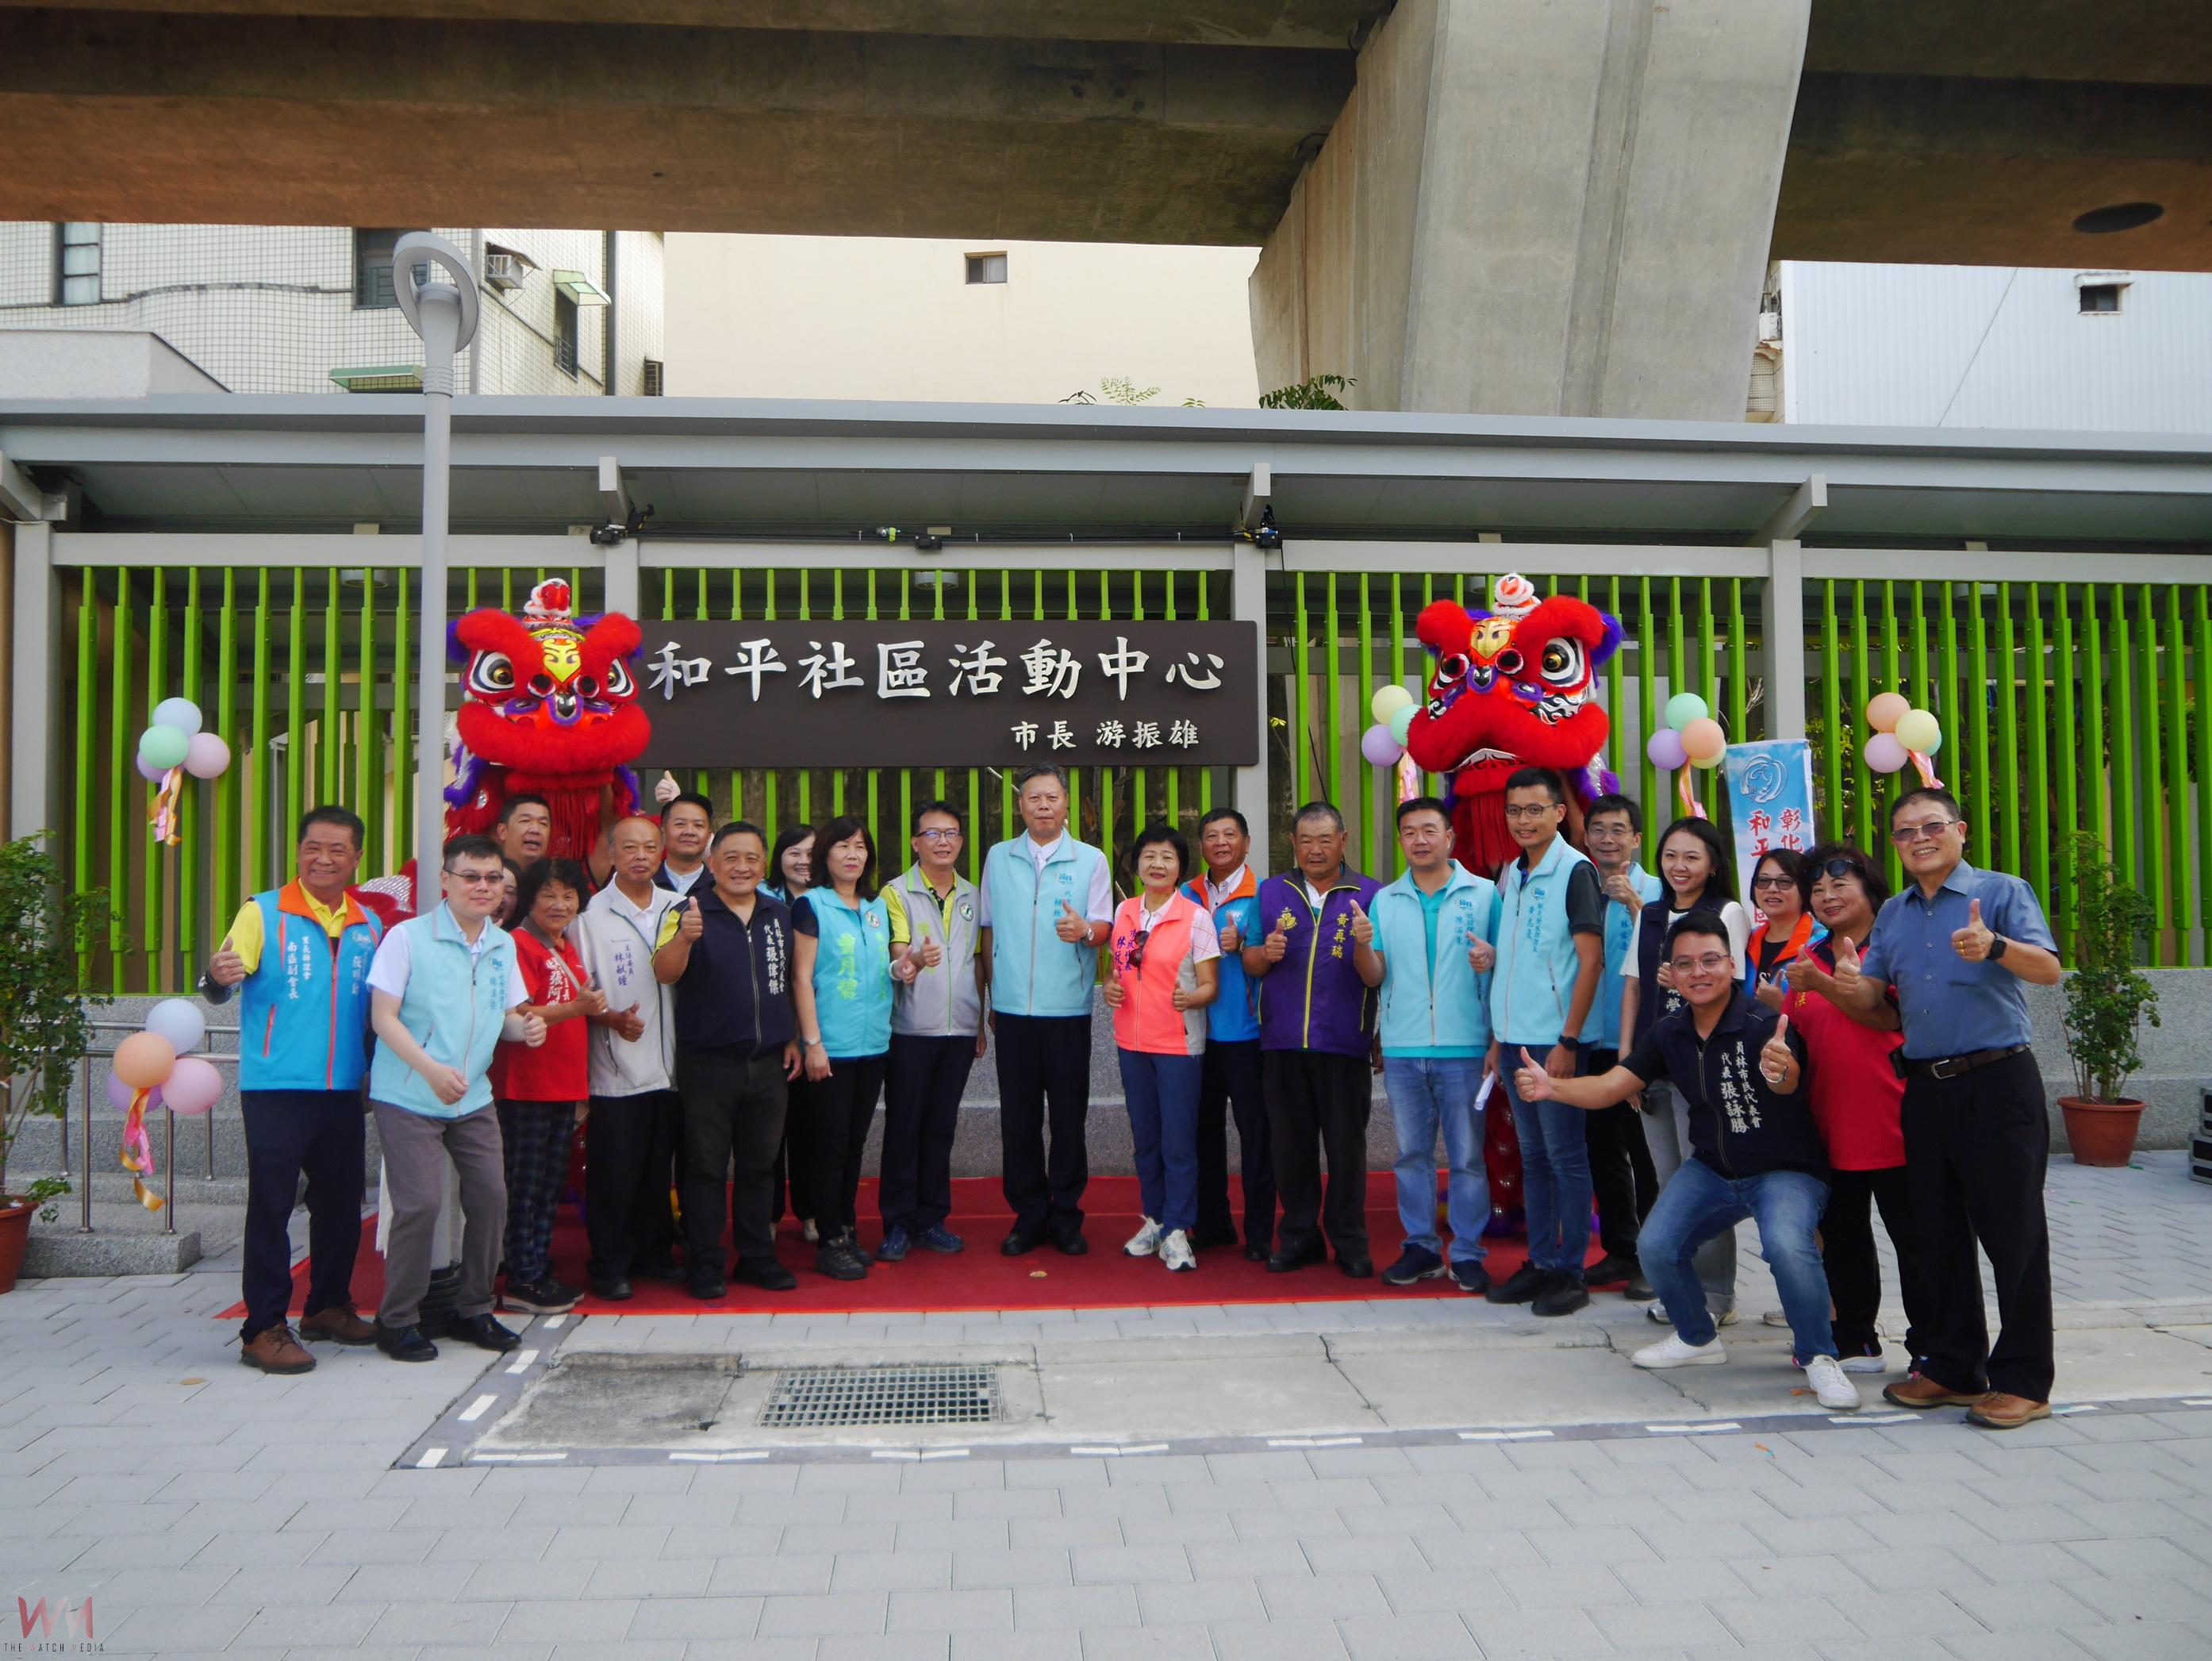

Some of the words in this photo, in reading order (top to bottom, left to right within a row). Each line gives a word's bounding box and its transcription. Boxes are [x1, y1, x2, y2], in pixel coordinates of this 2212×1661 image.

[647, 636, 1225, 702] 和平社區活動中心
[1010, 720, 1077, 751] 市長
[1096, 719, 1200, 750] 游振雄
[1735, 1040, 1762, 1128] 員林市民代表會
